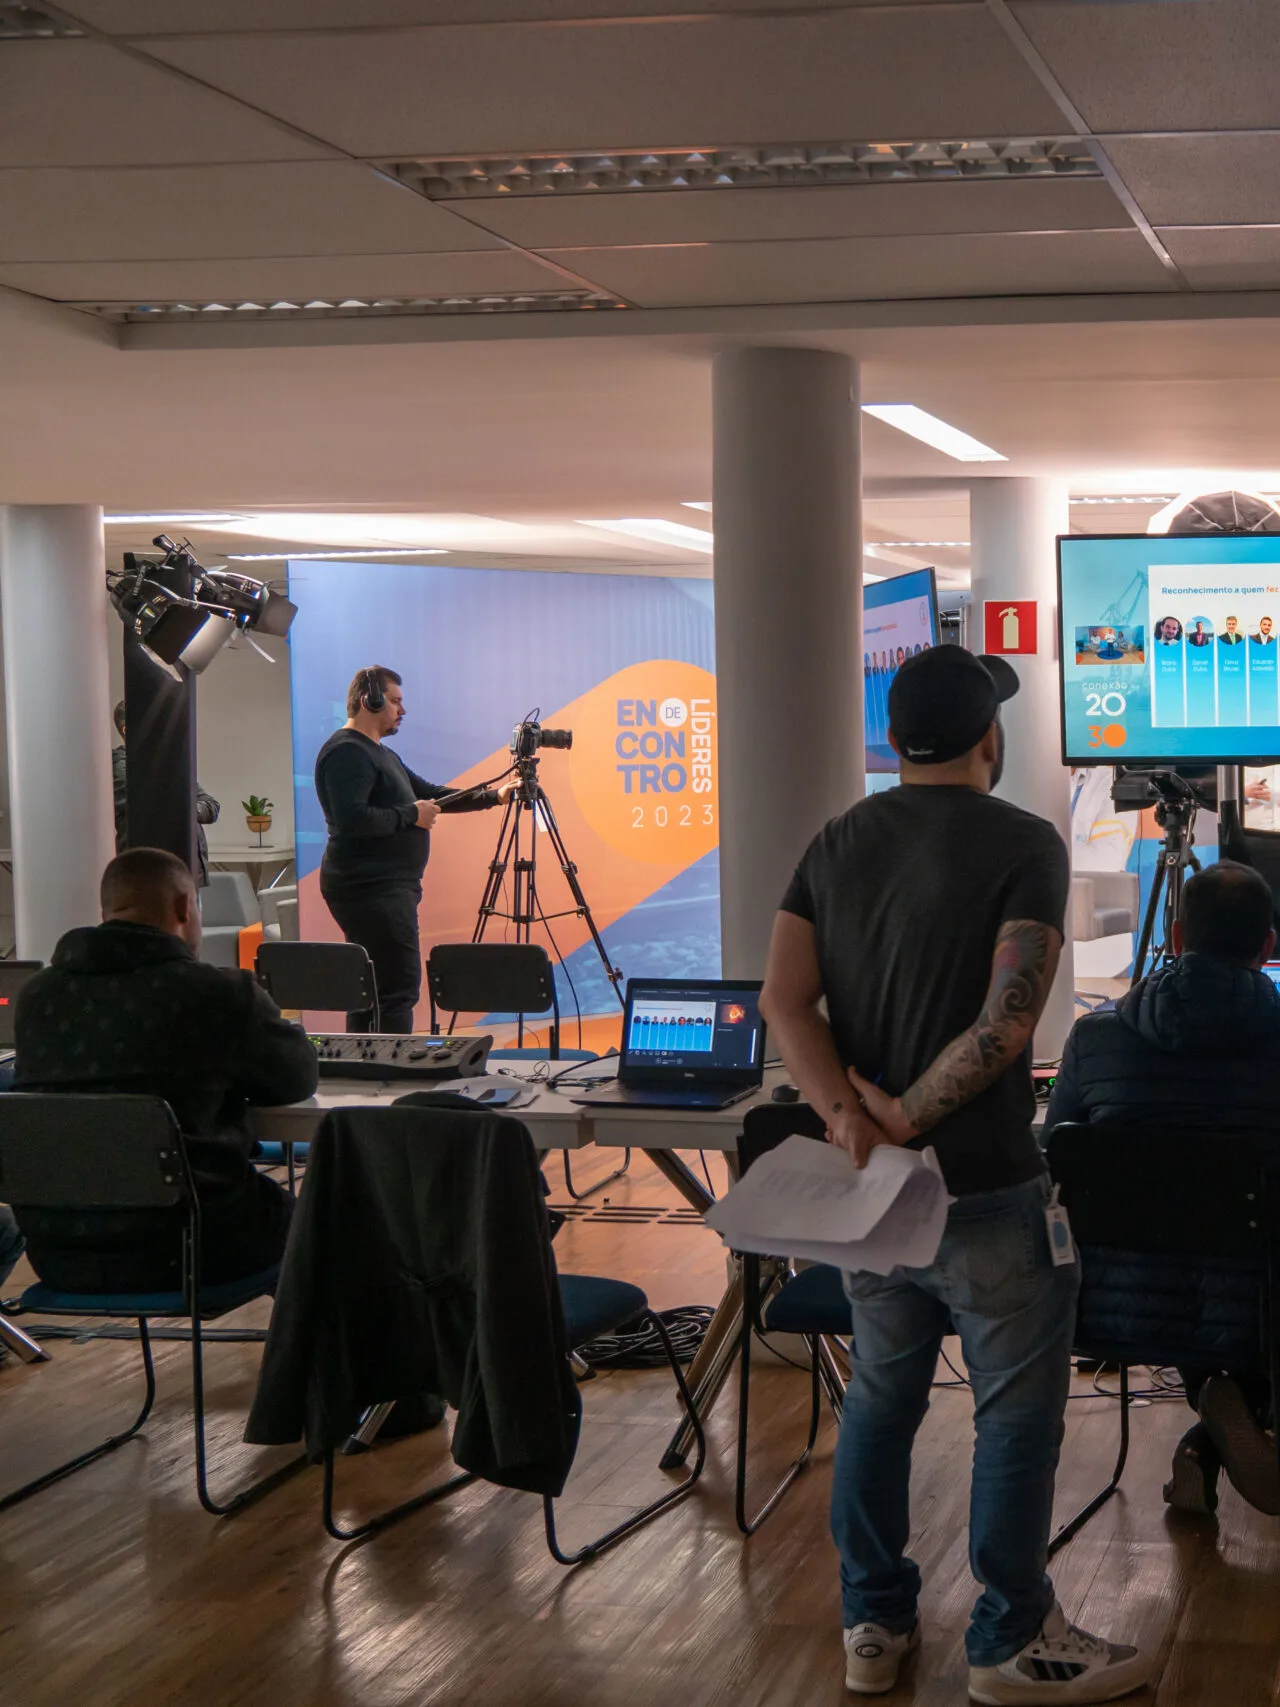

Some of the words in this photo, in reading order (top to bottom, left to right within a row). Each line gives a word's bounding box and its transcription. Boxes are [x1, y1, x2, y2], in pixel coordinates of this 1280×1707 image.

[1161, 586, 1233, 595] Reconhecimento
[1240, 586, 1265, 596] quem
[1266, 585, 1279, 593] fez
[1082, 681, 1129, 690] conexão
[616, 699, 657, 727] EN
[665, 706, 681, 719] DE
[1086, 692, 1127, 717] 20
[615, 730, 686, 760] CON
[690, 698, 716, 794] LÍDERES
[616, 762, 688, 794] TRO
[631, 804, 714, 828] 2023
